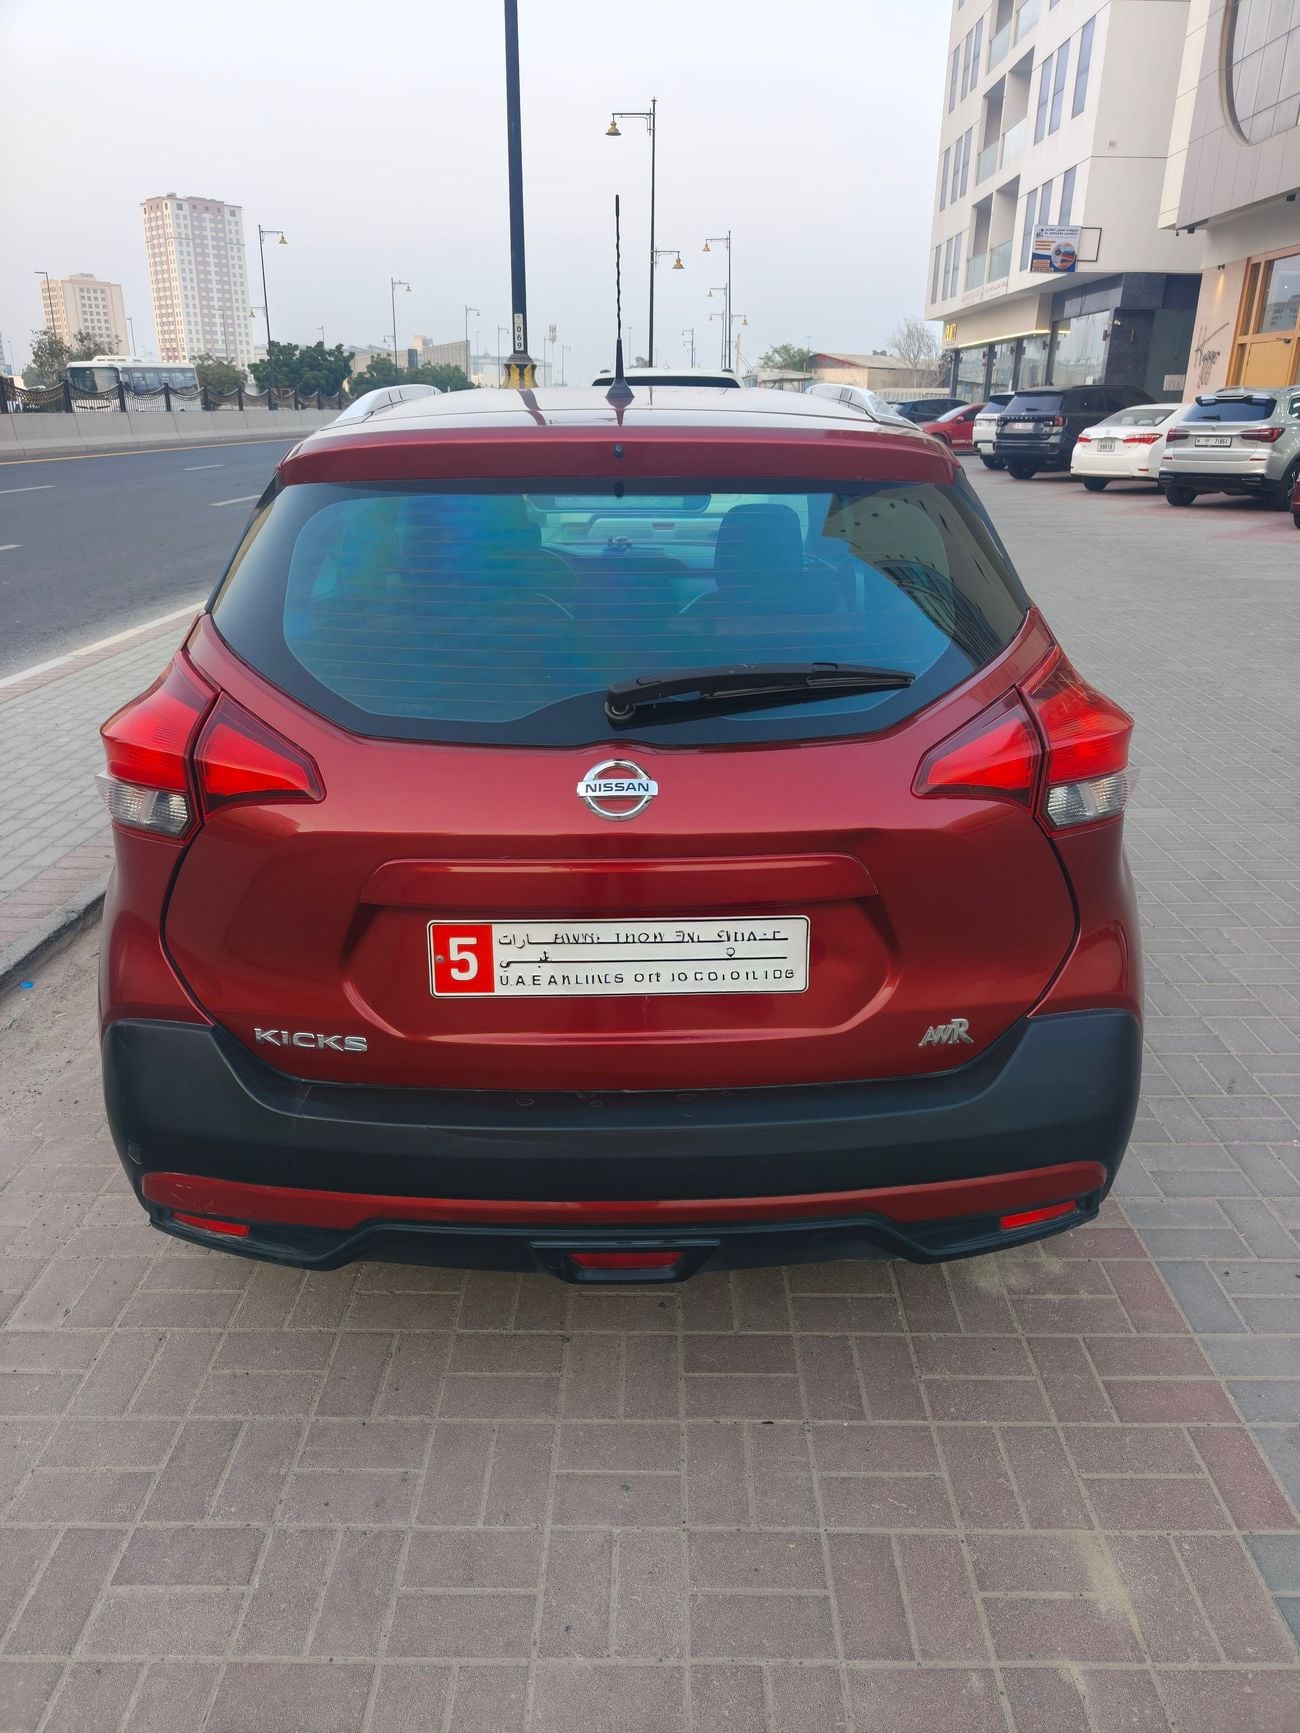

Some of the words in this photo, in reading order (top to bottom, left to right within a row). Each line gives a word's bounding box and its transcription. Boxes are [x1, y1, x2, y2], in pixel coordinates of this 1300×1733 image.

[585, 782, 649, 793] NISSAN
[449, 937, 478, 981] 5
[254, 1027, 368, 1052] KICKS
